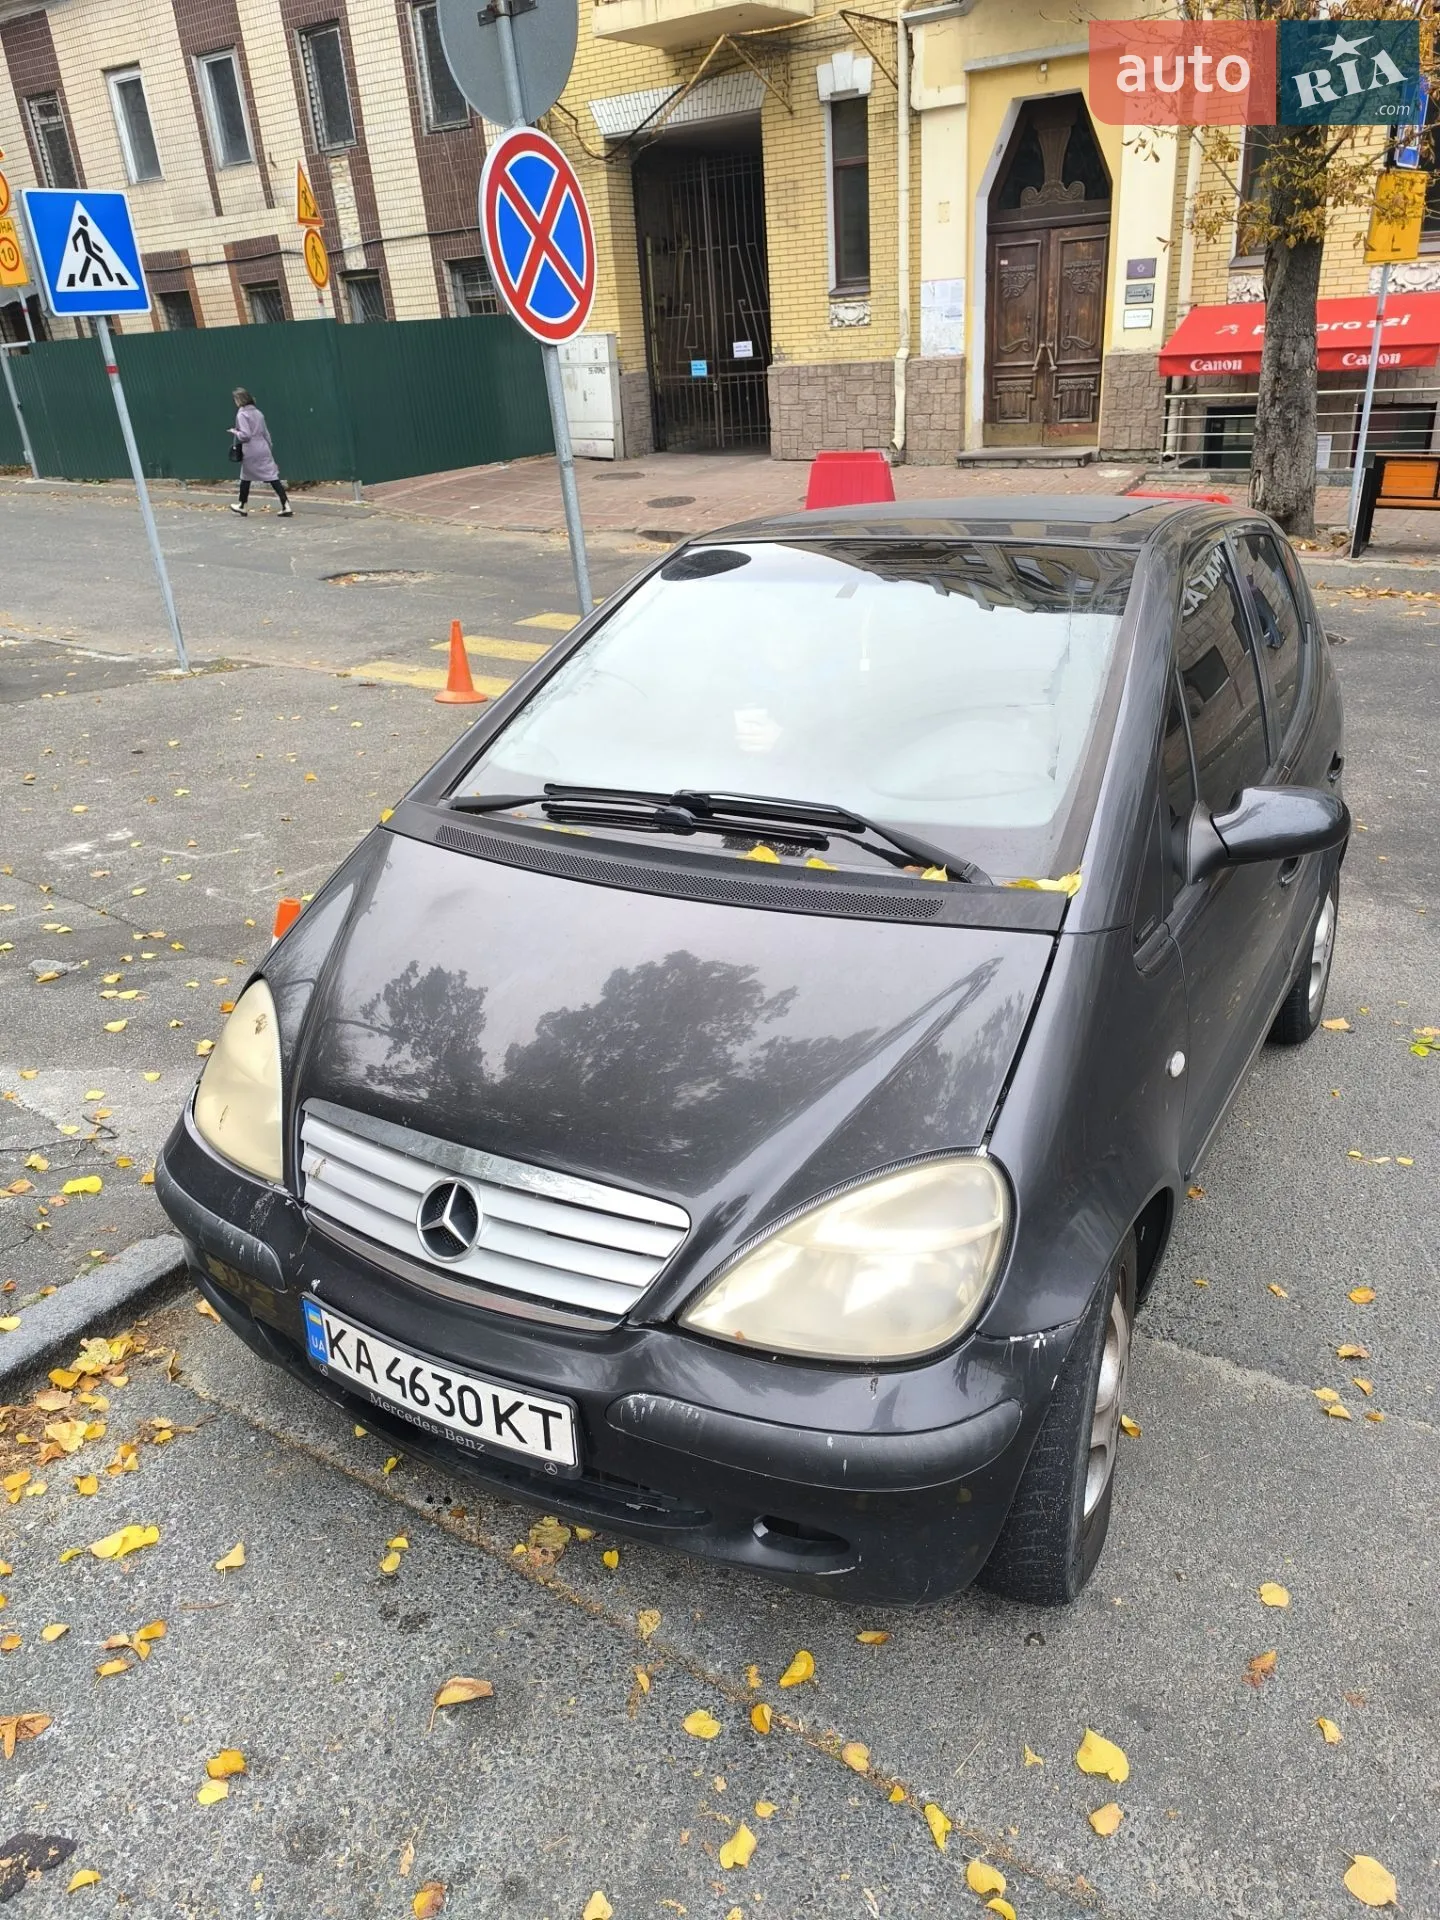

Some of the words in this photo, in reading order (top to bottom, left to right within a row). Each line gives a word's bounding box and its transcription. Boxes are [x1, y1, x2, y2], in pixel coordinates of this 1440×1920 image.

[1190, 358, 1243, 372] Canon
[311, 1337, 326, 1354] UA
[325, 1319, 379, 1385] KA
[385, 1357, 484, 1428] 4630
[491, 1393, 563, 1451] KT
[369, 1391, 486, 1453] Mercedes-Benz
